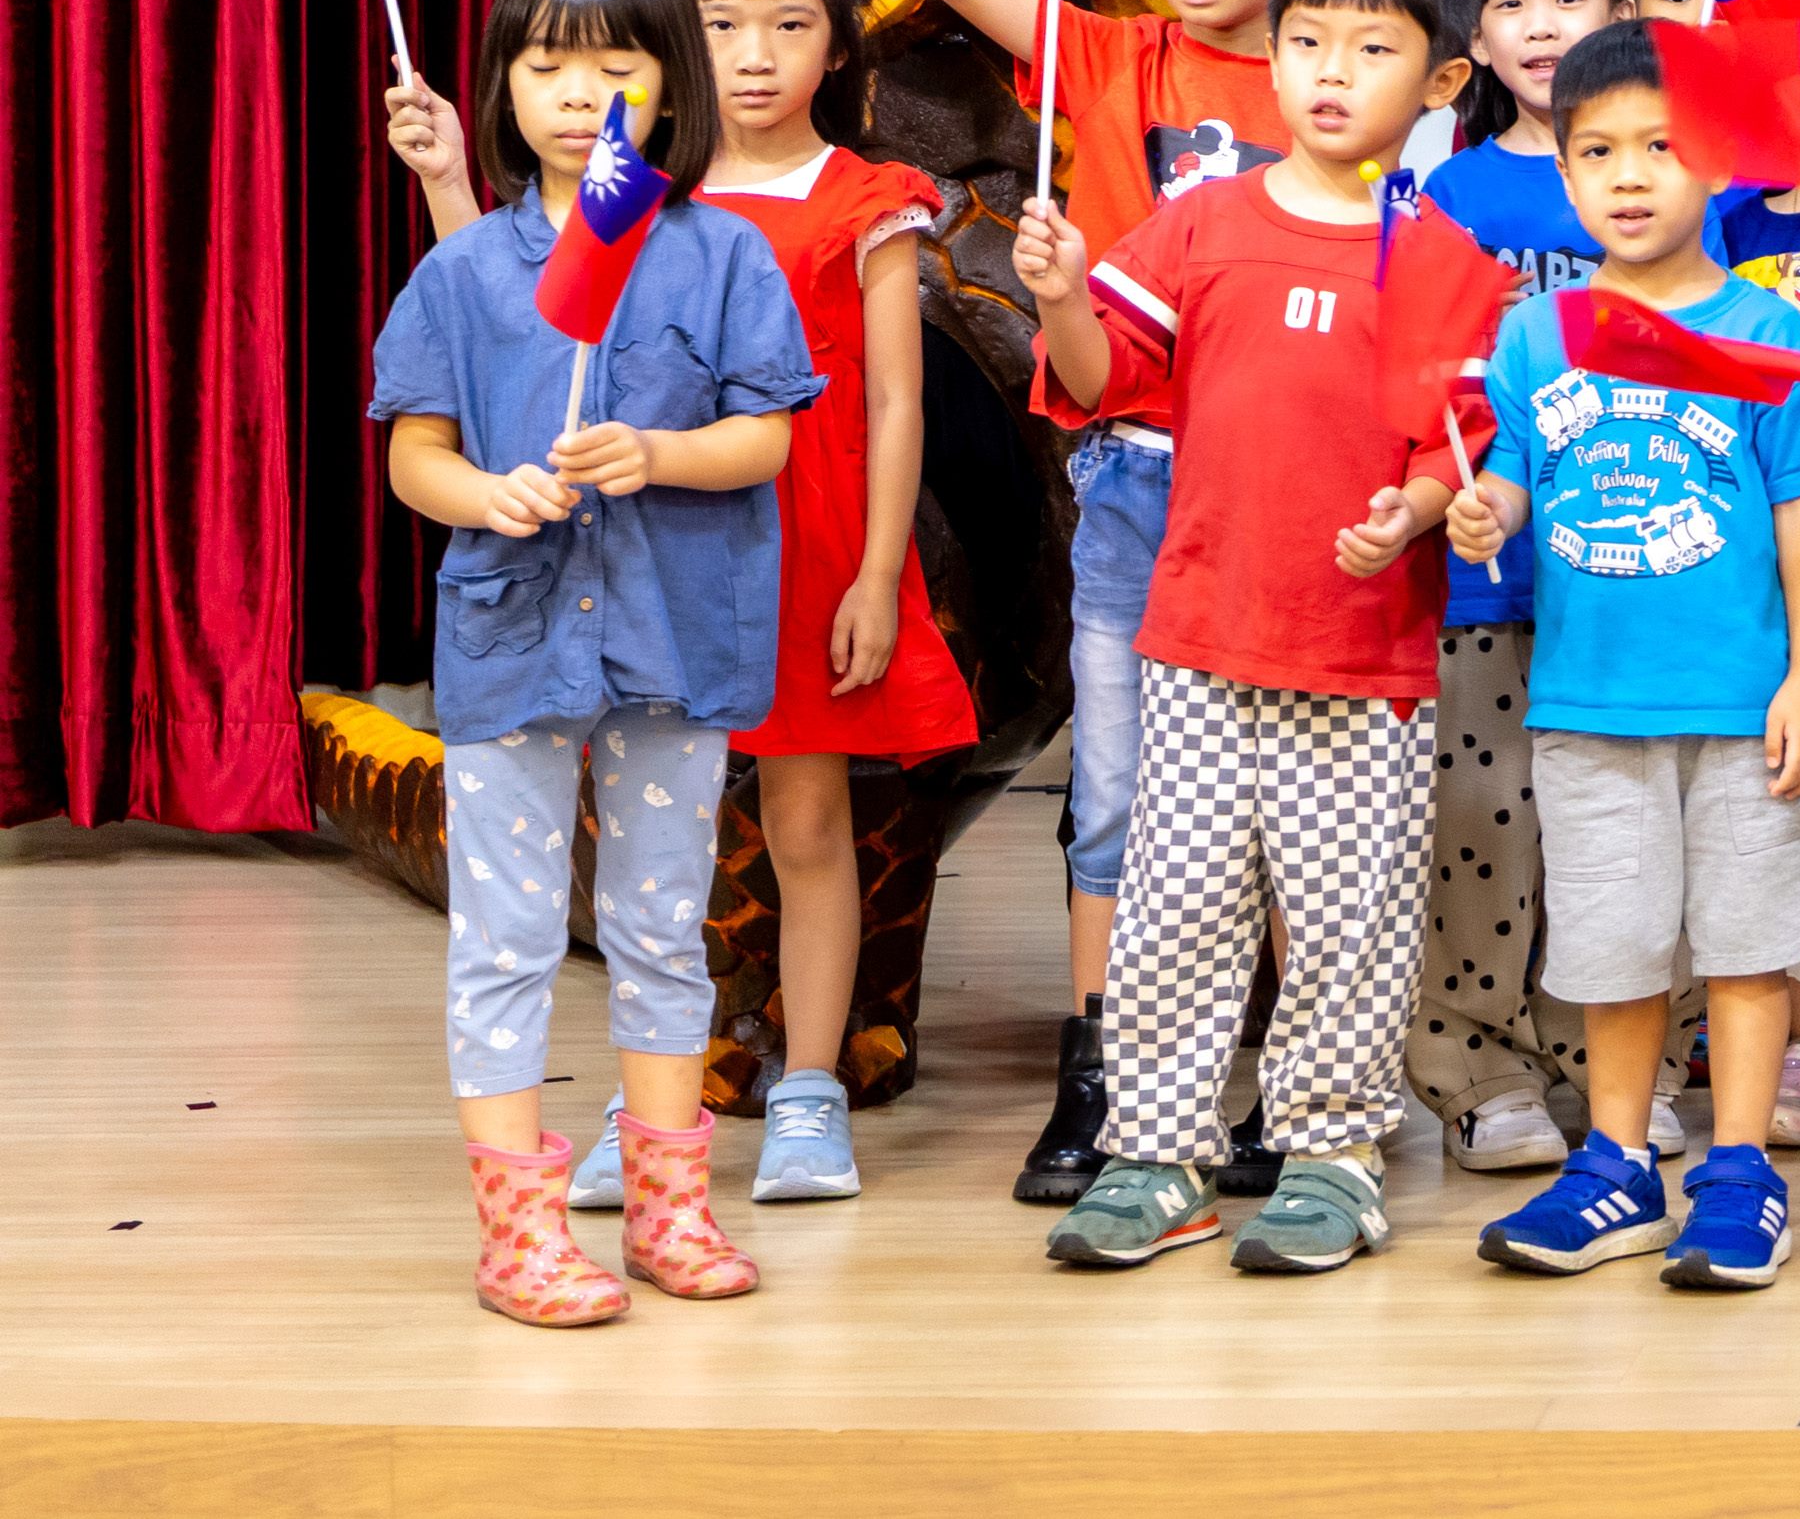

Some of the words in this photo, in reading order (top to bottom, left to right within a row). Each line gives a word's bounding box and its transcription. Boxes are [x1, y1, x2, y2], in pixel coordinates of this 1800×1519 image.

[1284, 286, 1337, 333] 01
[1573, 440, 1630, 469] Puffing
[1648, 434, 1691, 474] Billy
[1591, 467, 1660, 497] Railway
